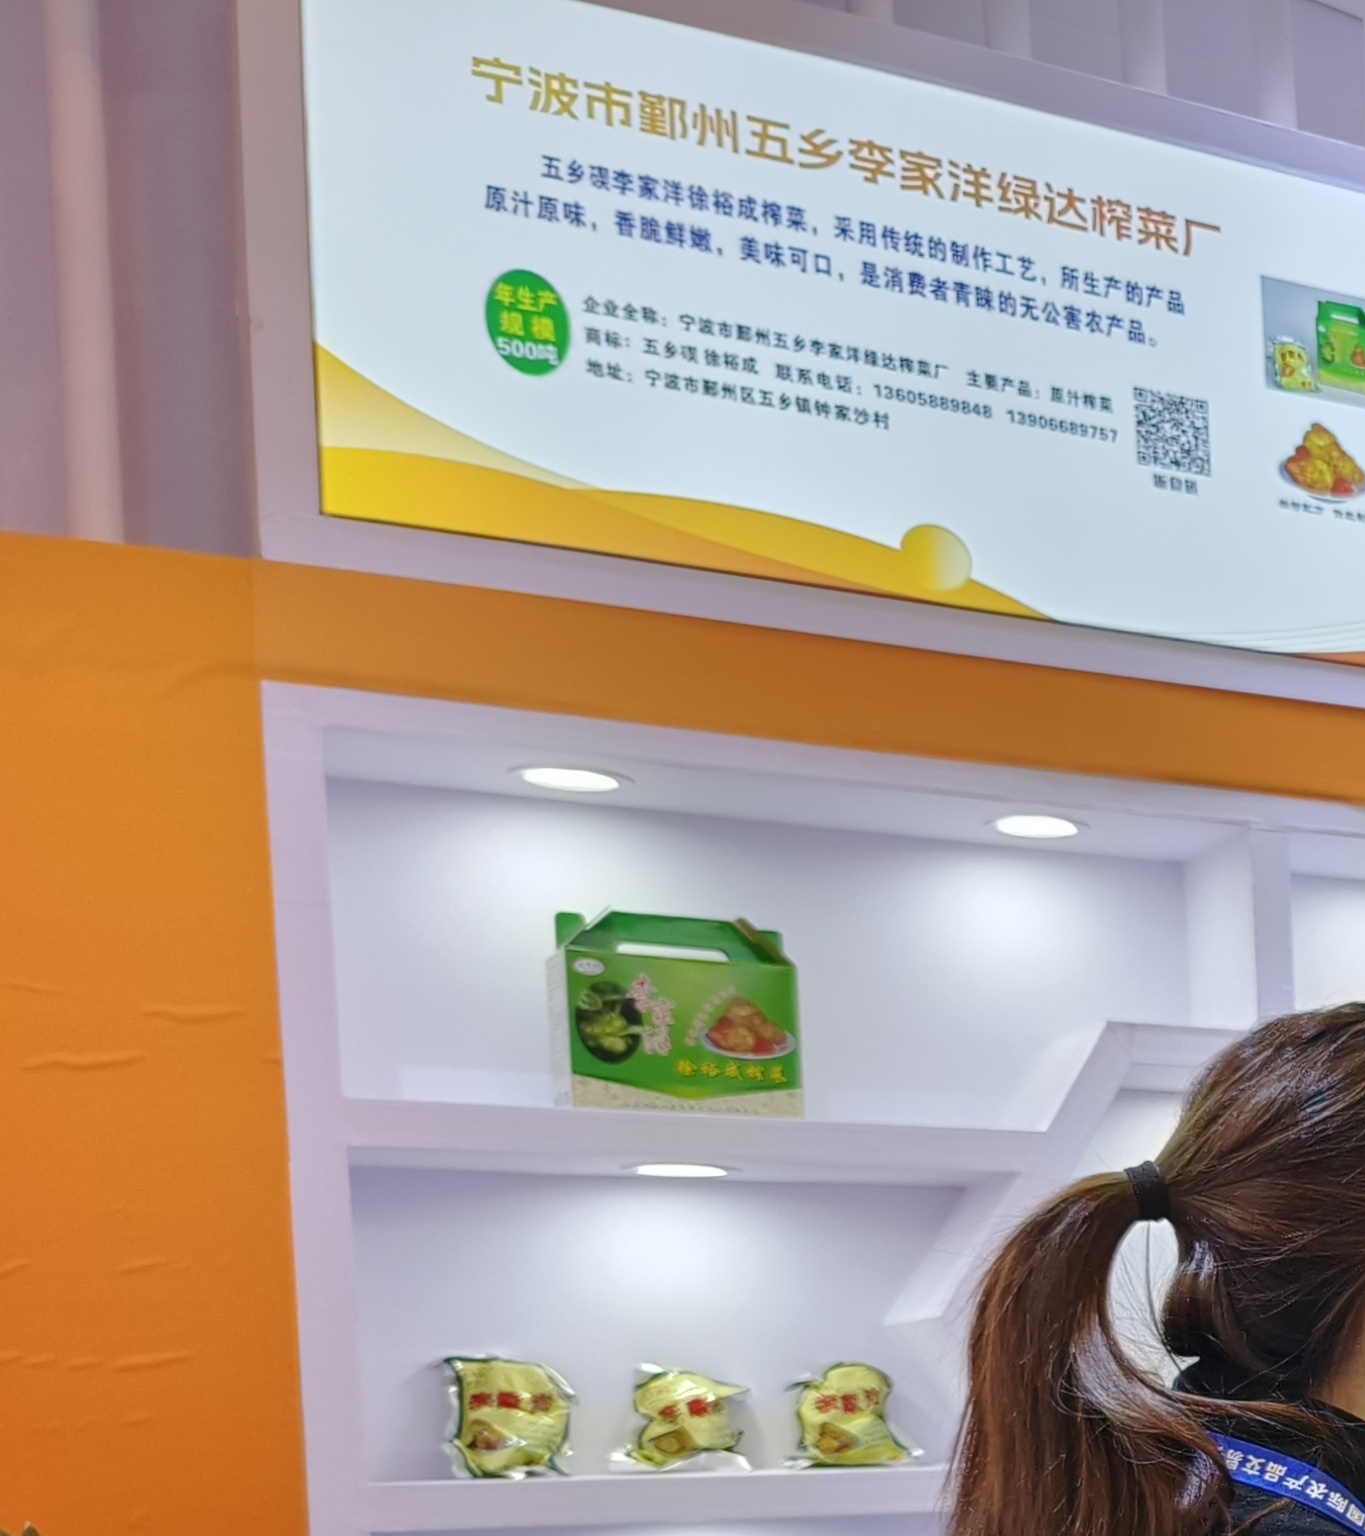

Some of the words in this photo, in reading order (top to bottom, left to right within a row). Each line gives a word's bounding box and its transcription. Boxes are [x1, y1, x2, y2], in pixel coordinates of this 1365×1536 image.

[471, 56, 1221, 256] 宁波市鄞州五乡李家洋绿达榨菜厂
